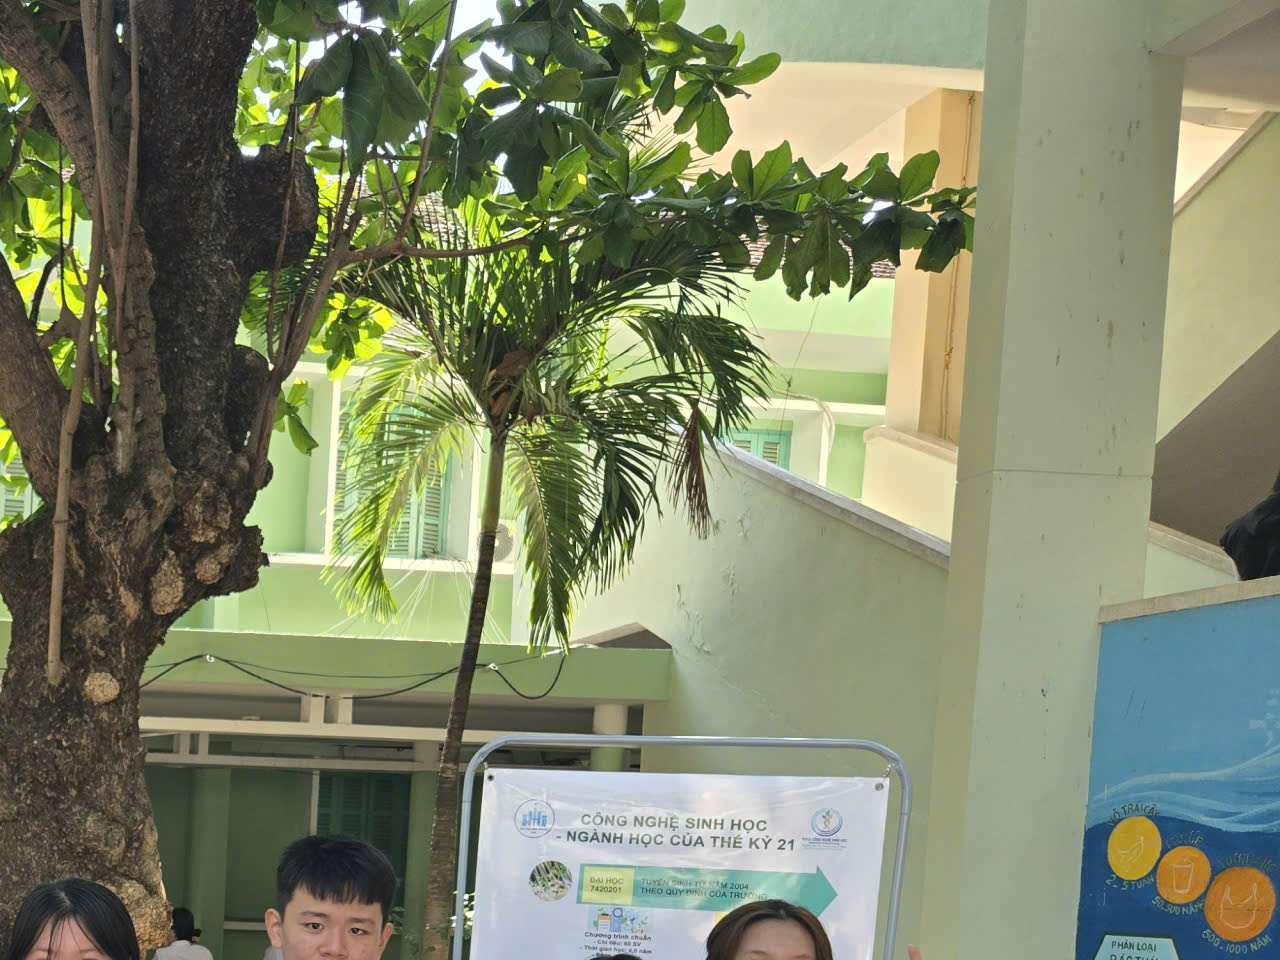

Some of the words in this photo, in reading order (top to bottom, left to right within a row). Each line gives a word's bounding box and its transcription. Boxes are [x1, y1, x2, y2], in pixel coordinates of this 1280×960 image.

[581, 812, 628, 828] CÔNG
[632, 813, 680, 831] NGHỆ
[684, 816, 725, 831] SINH
[730, 818, 768, 833] HỌC
[566, 829, 623, 844] NGÀNH
[628, 832, 665, 848] HỌC
[669, 831, 705, 848] CỦA
[777, 838, 796, 851] 21
[589, 885, 623, 894] 7420201
[640, 887, 664, 896] THEO
[729, 883, 750, 891] 2004
